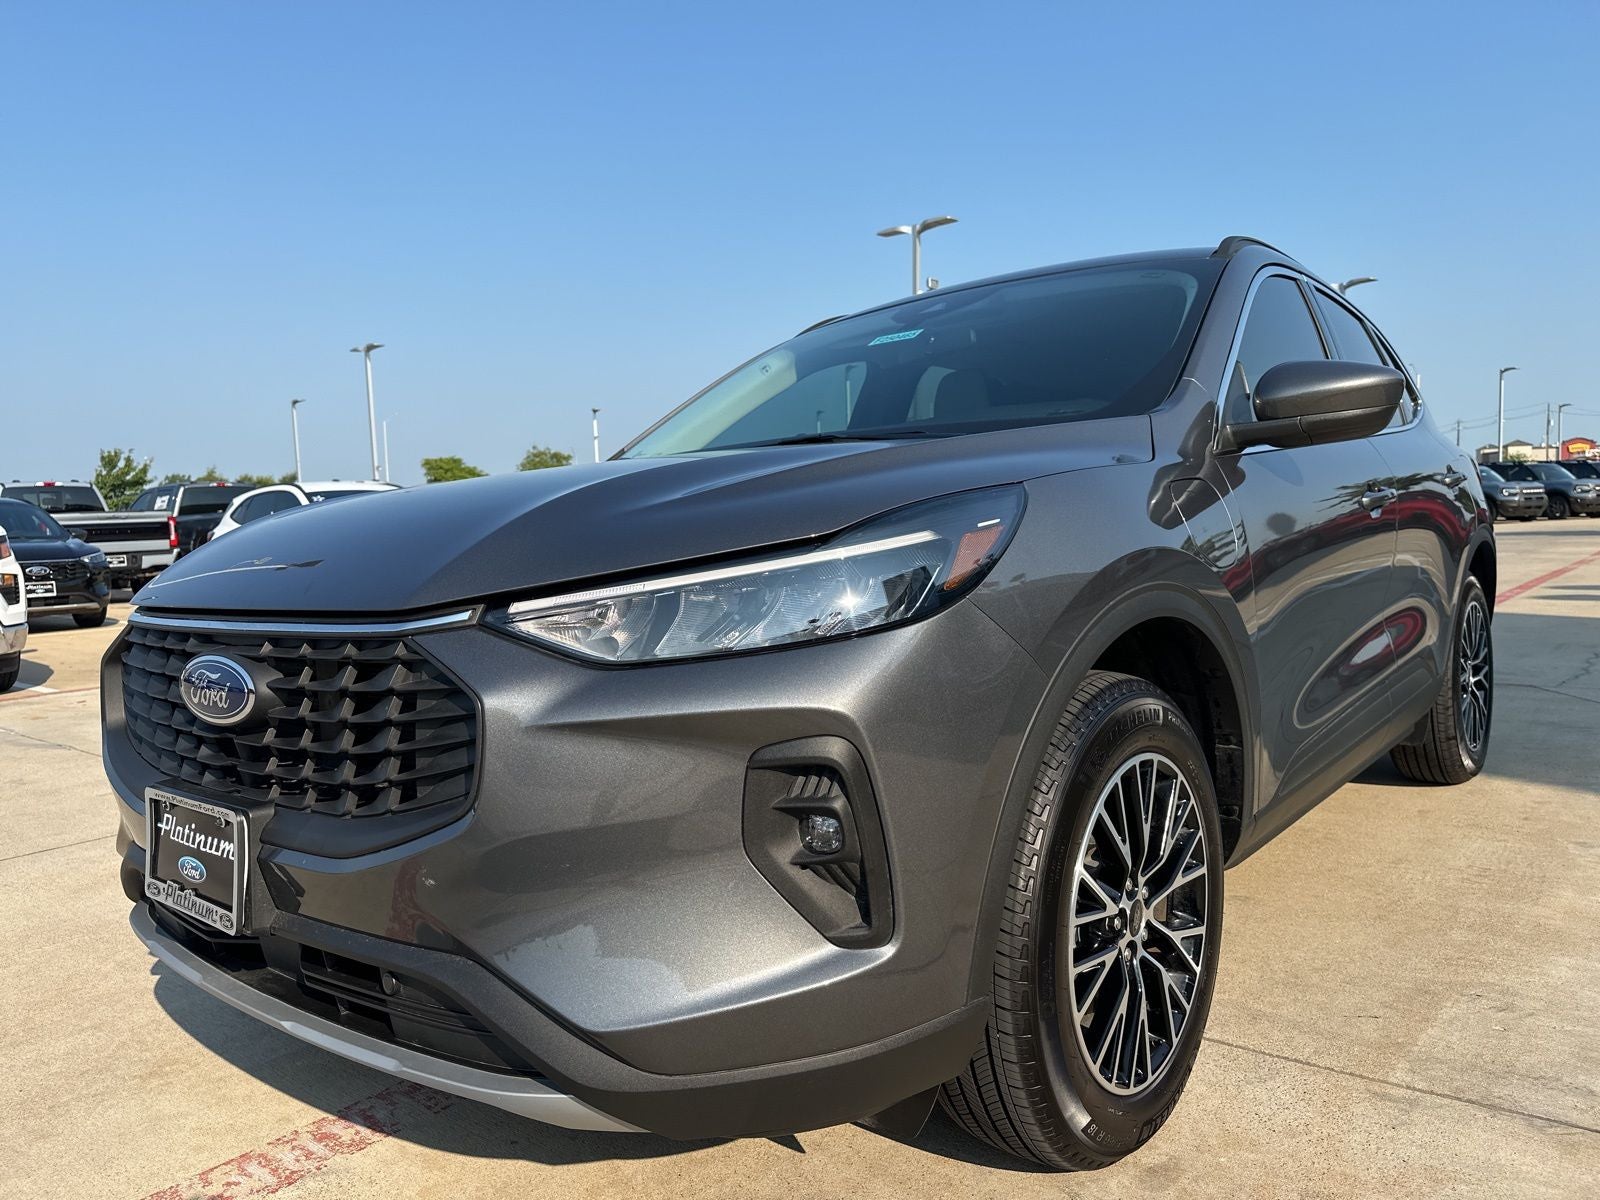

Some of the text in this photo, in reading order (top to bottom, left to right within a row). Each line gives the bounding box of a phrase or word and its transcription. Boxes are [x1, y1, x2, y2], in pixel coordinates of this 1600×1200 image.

[189, 669, 230, 708] Ford
[157, 813, 235, 860] Platinum
[182, 858, 201, 880] Ford
[164, 882, 217, 924] Platinum
